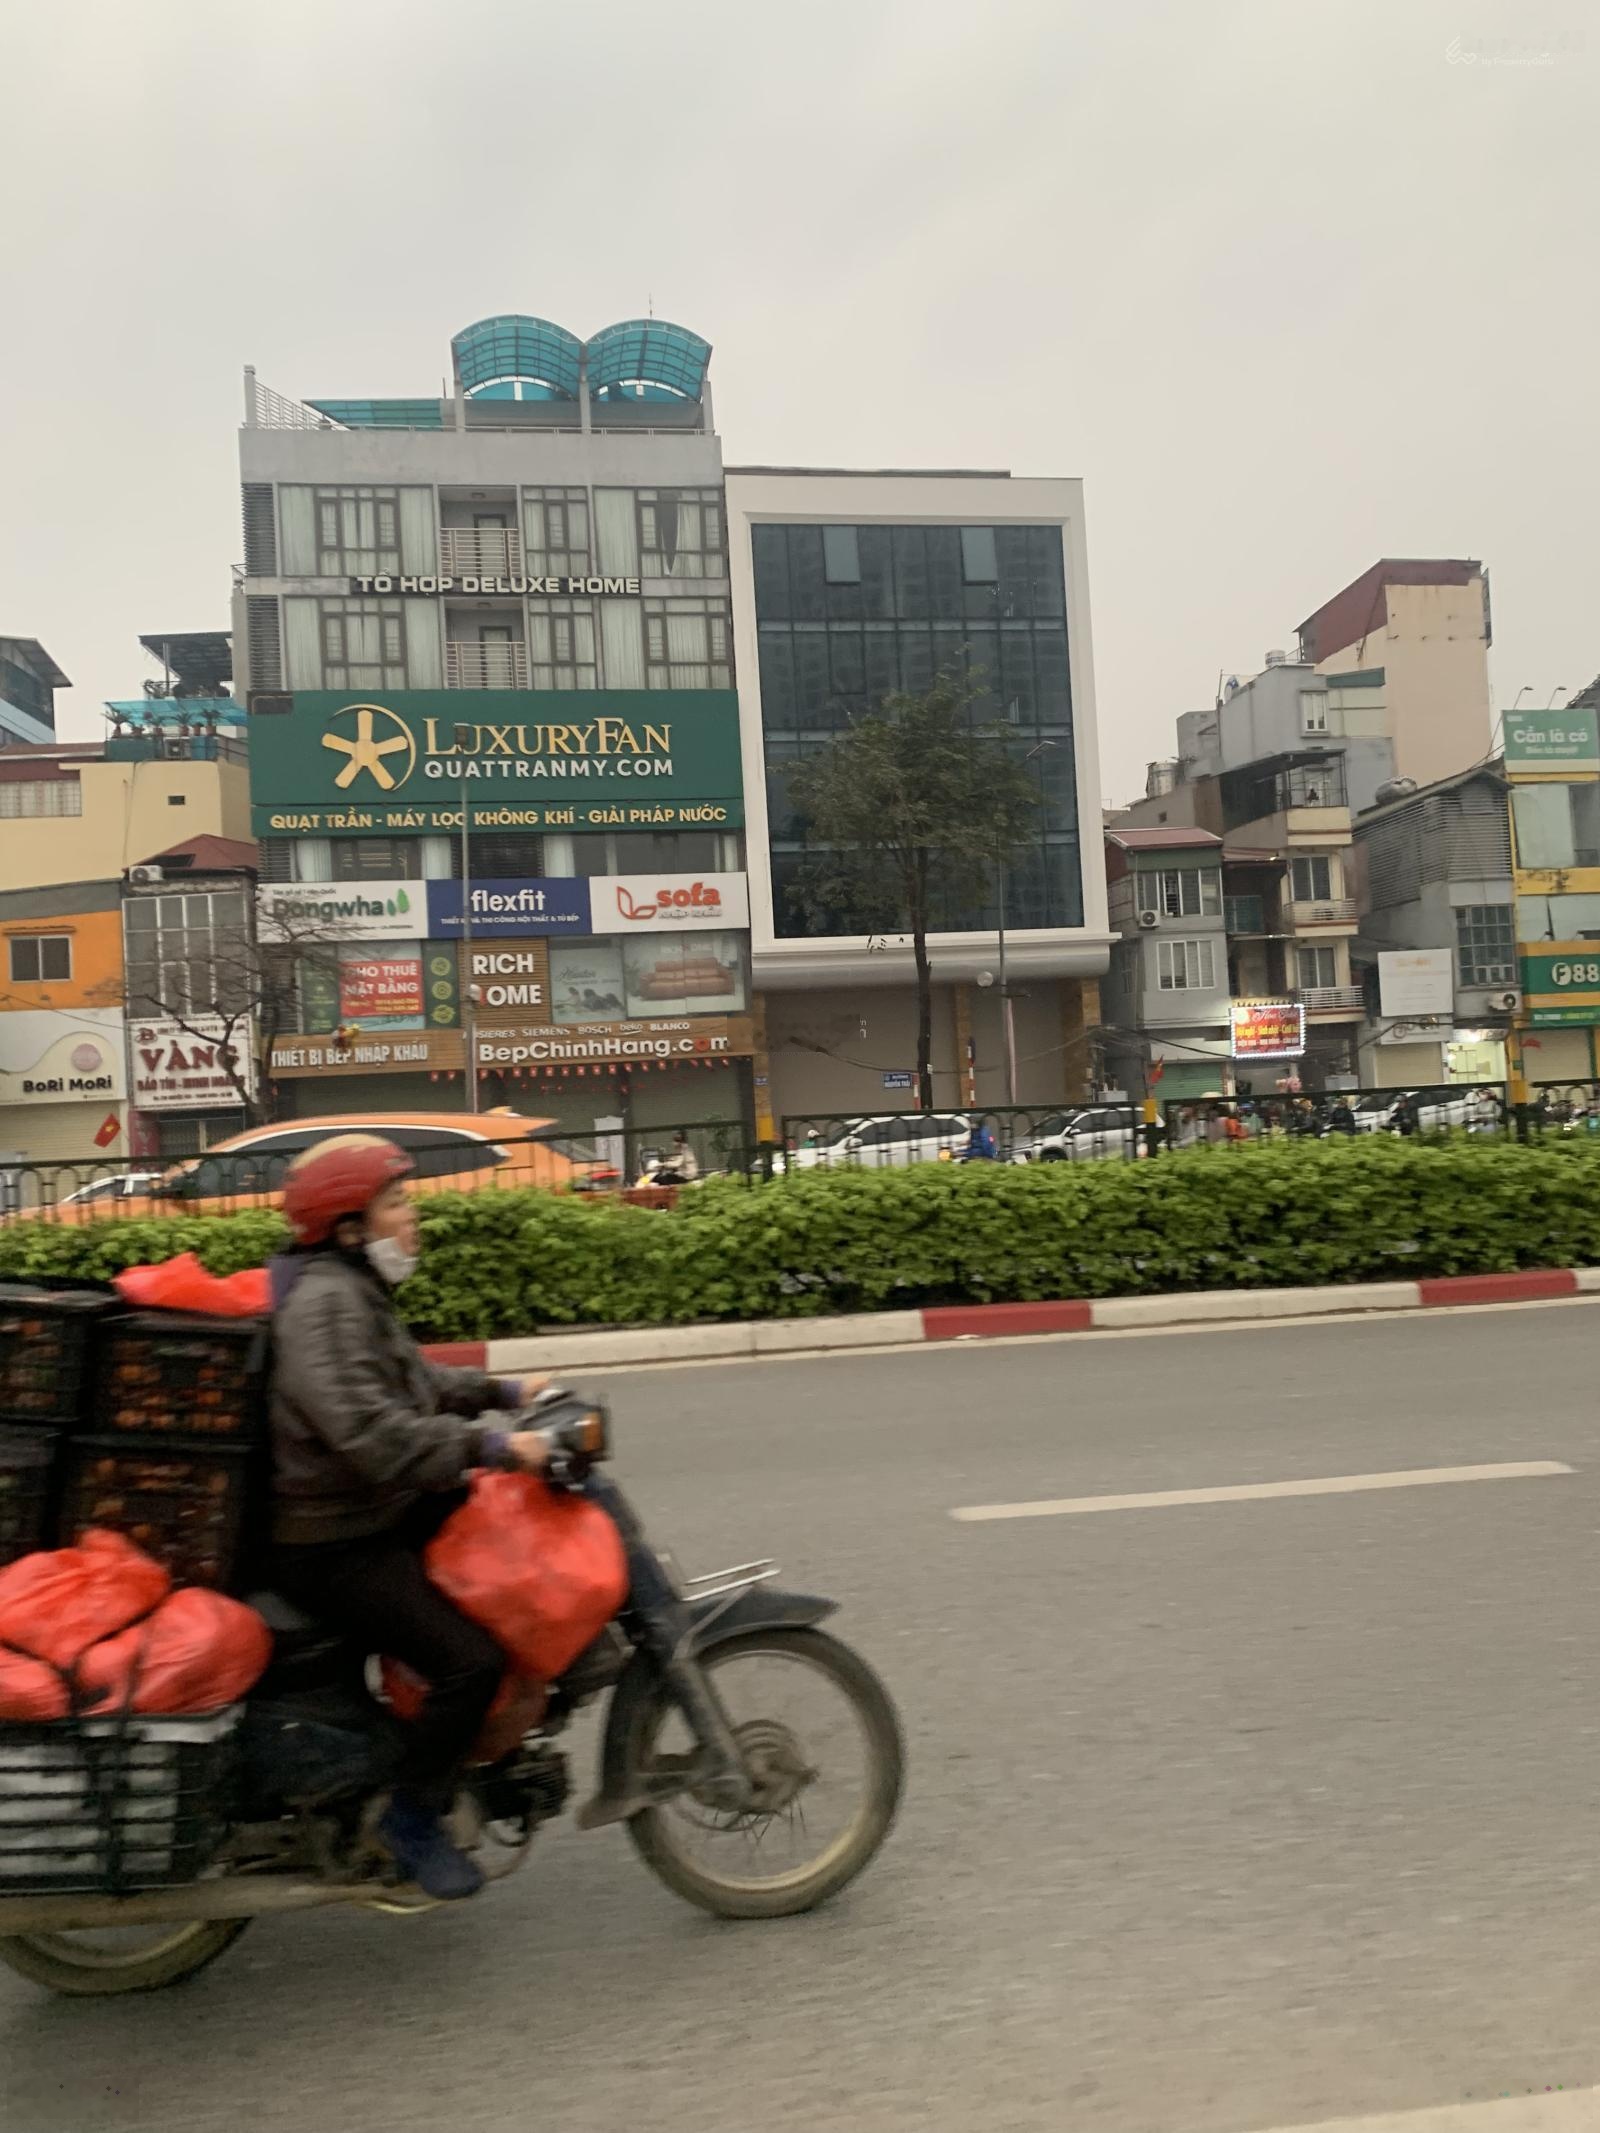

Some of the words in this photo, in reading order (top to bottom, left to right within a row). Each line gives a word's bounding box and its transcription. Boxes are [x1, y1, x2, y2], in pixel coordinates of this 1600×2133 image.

[462, 576, 560, 593] DELUXE
[568, 576, 641, 594] HOME
[424, 758, 673, 779] QUATTRANMY.COM
[270, 814, 319, 832] QUẠT
[326, 806, 373, 828] TRẦN
[387, 808, 425, 827] MÁY
[432, 812, 467, 830] LỌC
[474, 806, 539, 826] KHÔNG
[545, 806, 574, 824] KHÍ
[589, 805, 625, 824] GIẢI
[629, 805, 675, 823] PHÁP
[679, 803, 727, 822] NƯỚC
[470, 889, 545, 912] flexfit
[656, 881, 721, 908] sofa
[272, 895, 384, 923] Dongwha
[382, 962, 417, 976] THUÊ
[472, 953, 534, 975] RICH
[1552, 962, 1600, 986] F88
[378, 978, 418, 994] BẰNG
[522, 1026, 571, 1037] SIEMENS
[577, 1024, 612, 1035] BOSCH
[650, 1021, 690, 1031] BLANCO
[139, 1040, 240, 1073] VÀNG
[308, 1049, 322, 1070] BỊ
[480, 1036, 728, 1064] BepChinhHang.com
